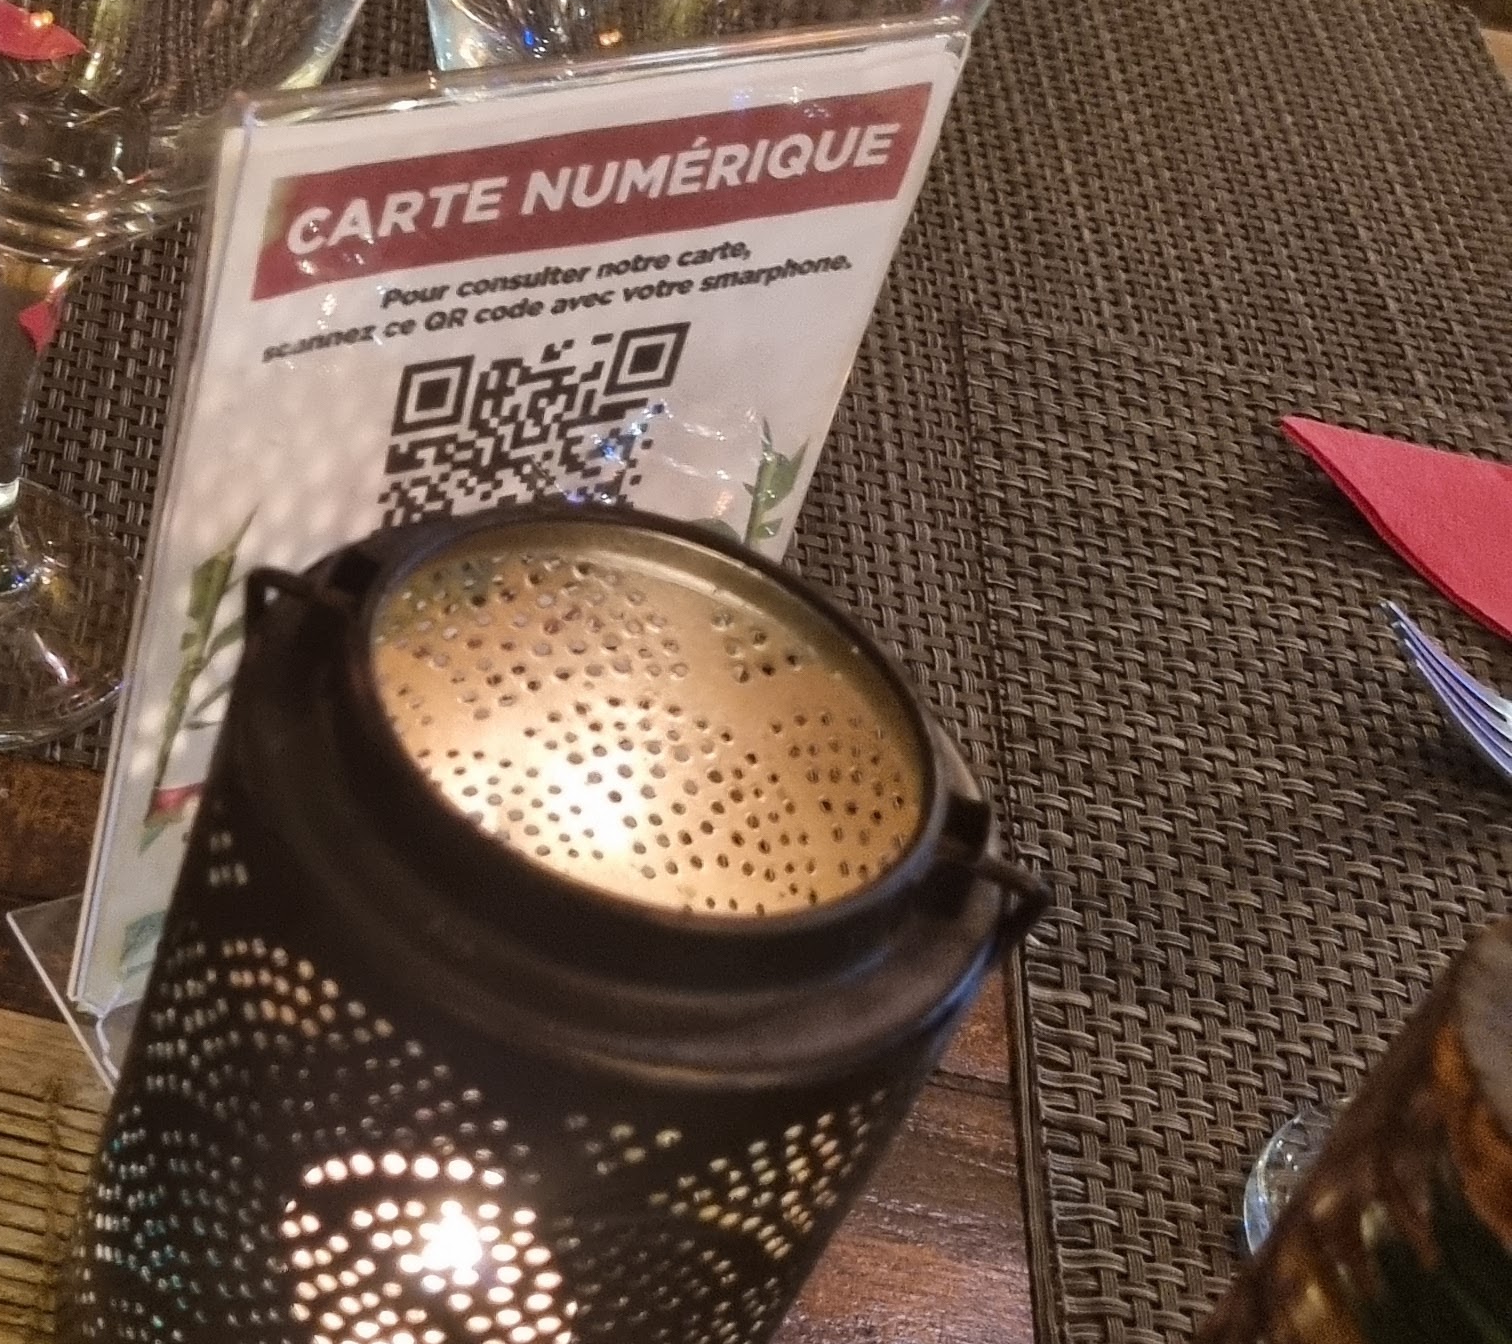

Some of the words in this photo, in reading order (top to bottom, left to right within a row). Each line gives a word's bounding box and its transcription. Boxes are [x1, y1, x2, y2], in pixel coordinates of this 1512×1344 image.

[287, 176, 509, 255] CARTE
[521, 122, 901, 215] NUMÉRIQUE
[380, 285, 450, 309] Pour
[456, 265, 591, 298] consulter
[596, 254, 671, 279] notre
[676, 240, 751, 268] carte,
[383, 319, 416, 338] ce
[424, 307, 469, 332] QR
[474, 297, 544, 324] code
[550, 289, 616, 315] avec
[623, 278, 694, 303] votre
